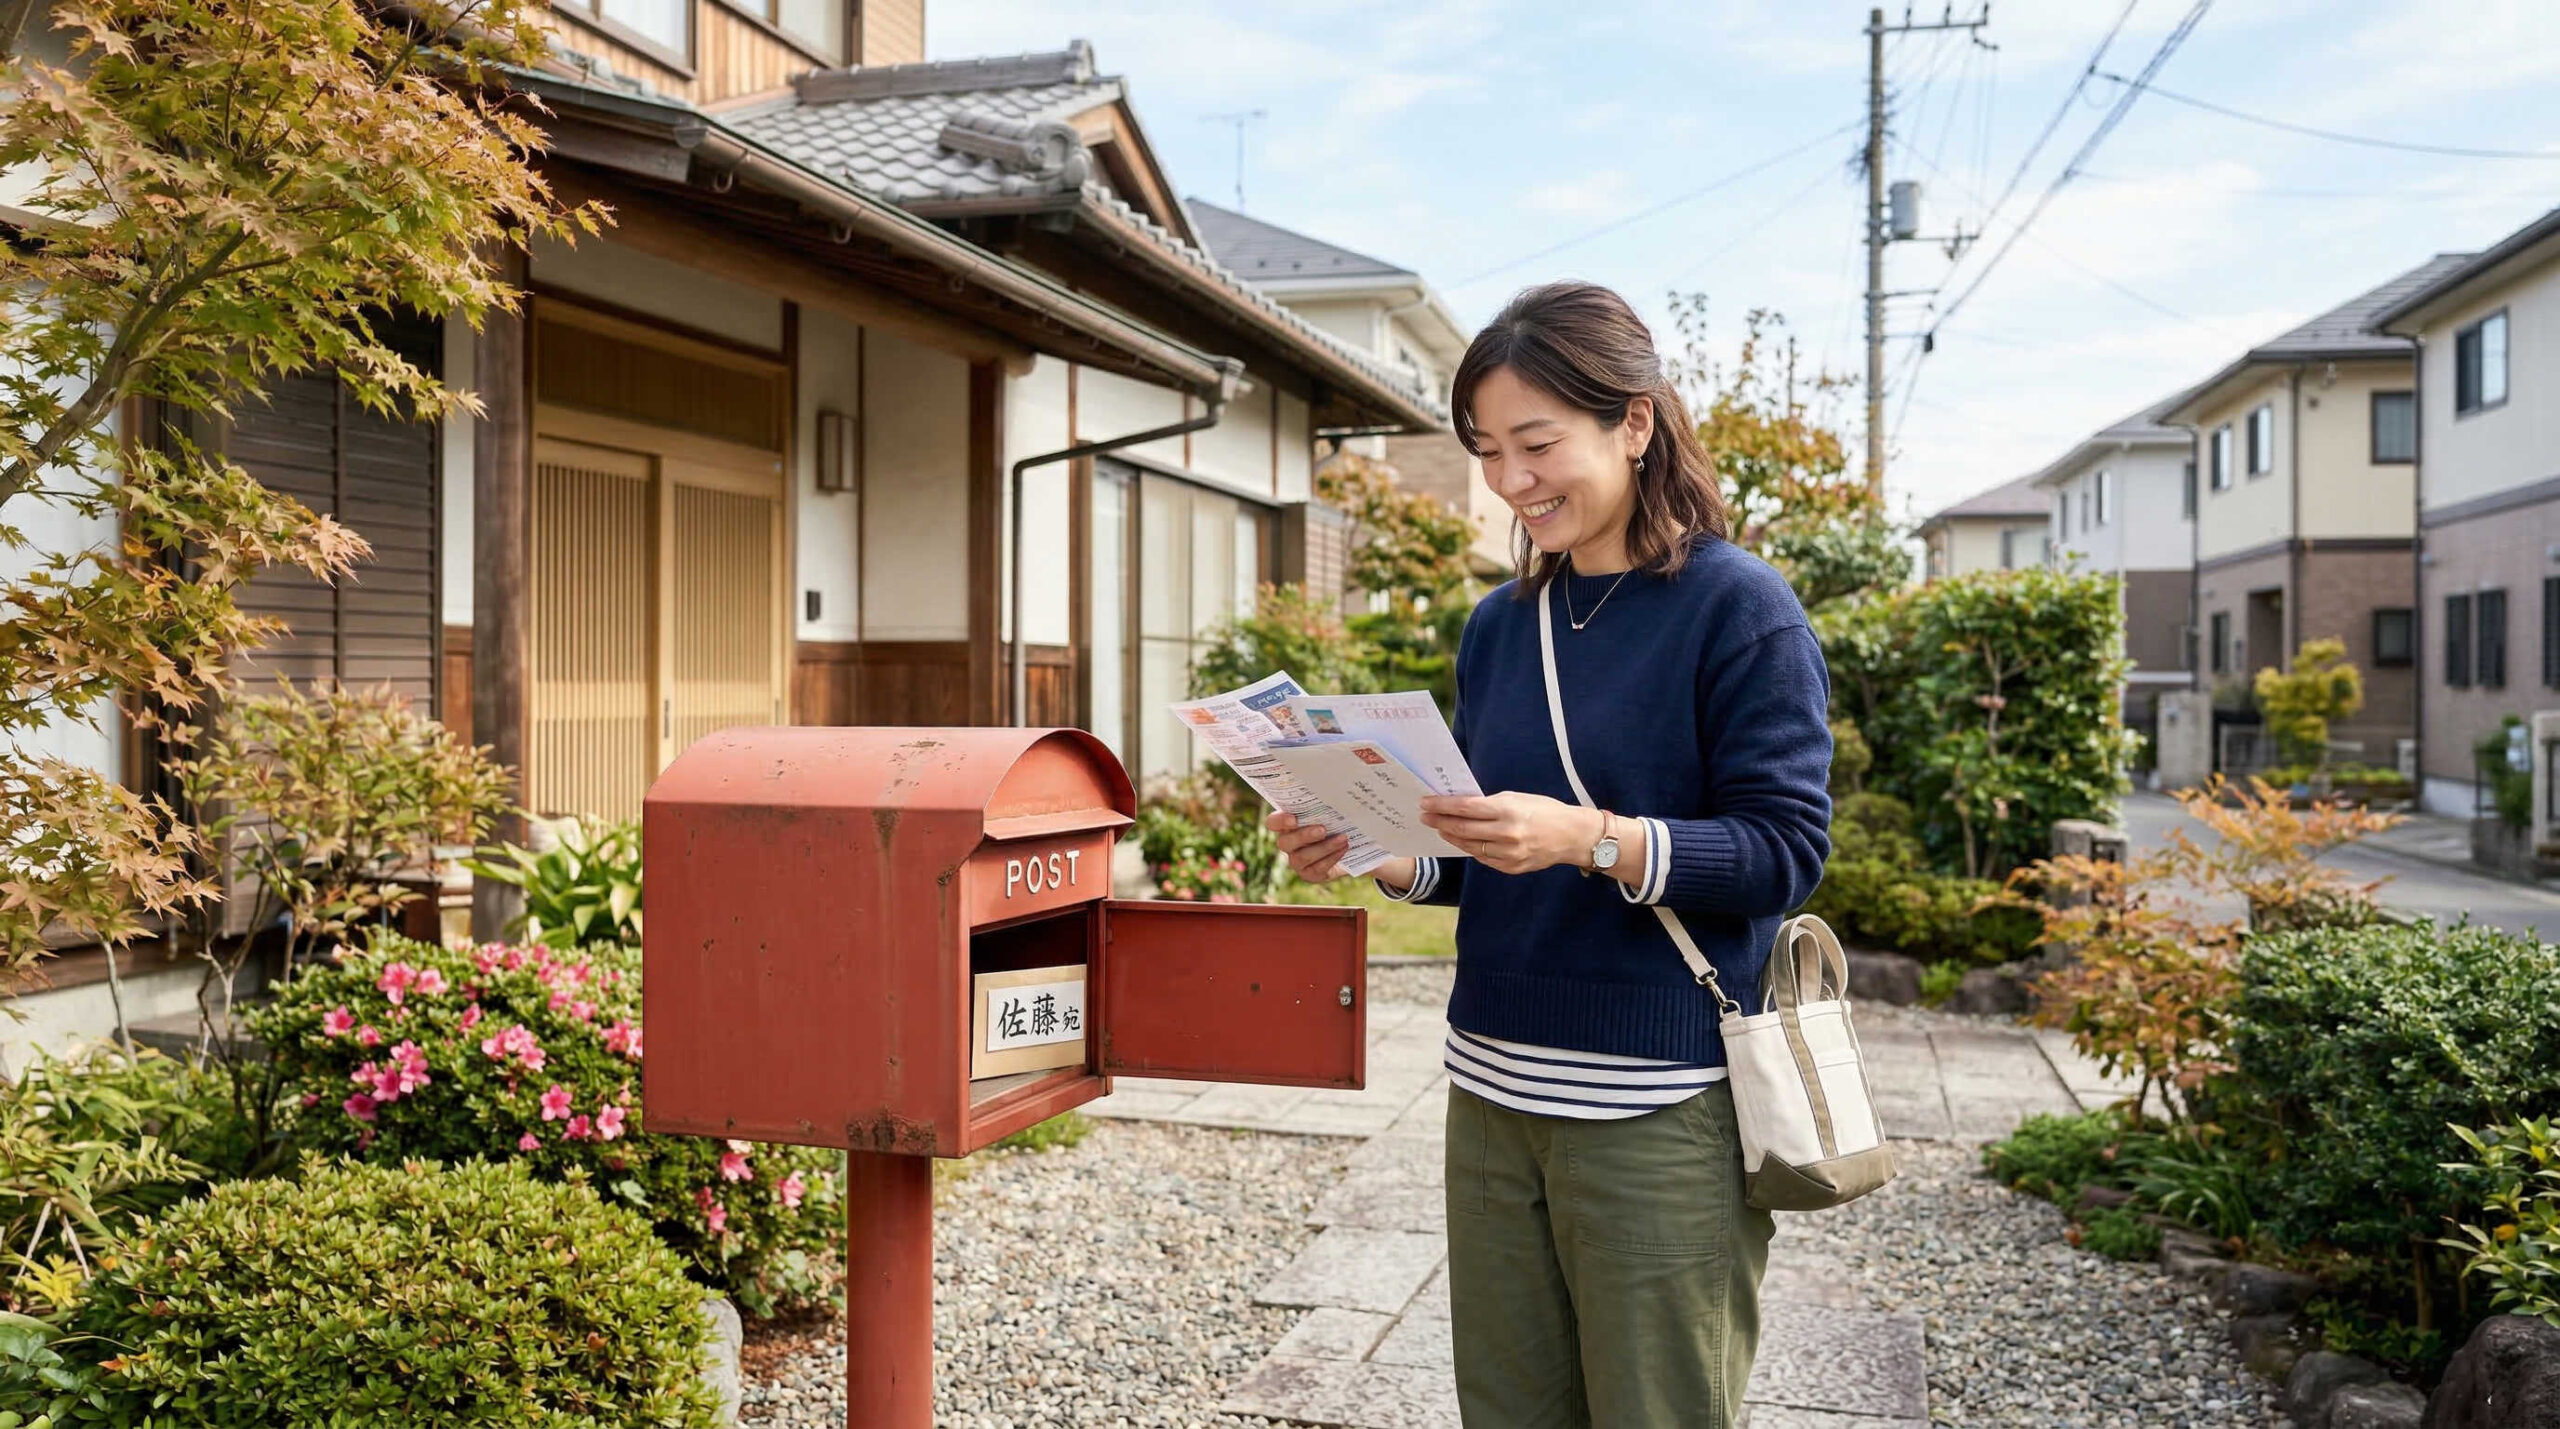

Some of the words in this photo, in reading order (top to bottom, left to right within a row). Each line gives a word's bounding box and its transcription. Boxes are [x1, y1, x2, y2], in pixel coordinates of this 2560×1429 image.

[1006, 850, 1080, 898] POST
[997, 993, 1081, 1041] 佐藤宛
